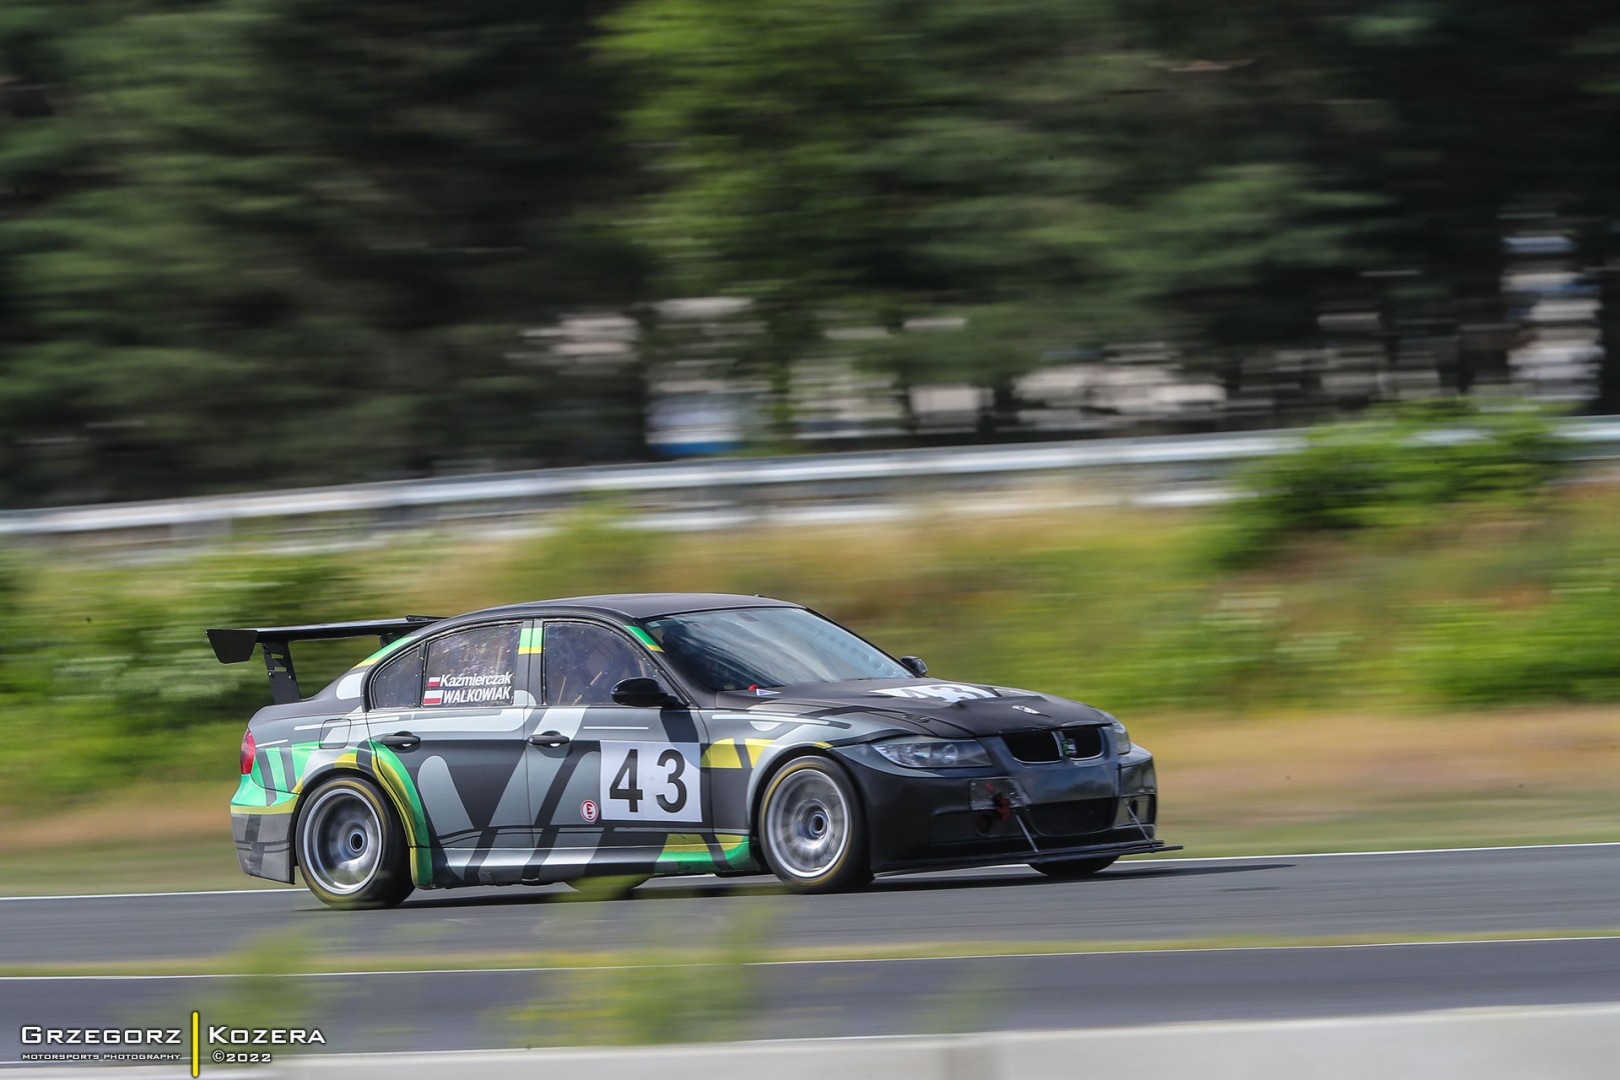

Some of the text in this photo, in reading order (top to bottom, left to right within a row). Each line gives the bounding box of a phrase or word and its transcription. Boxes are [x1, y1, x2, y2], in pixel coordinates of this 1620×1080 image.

[440, 671, 513, 687] Kaźmierczak
[443, 686, 512, 704] WALKOWIAK
[609, 748, 688, 813] 43
